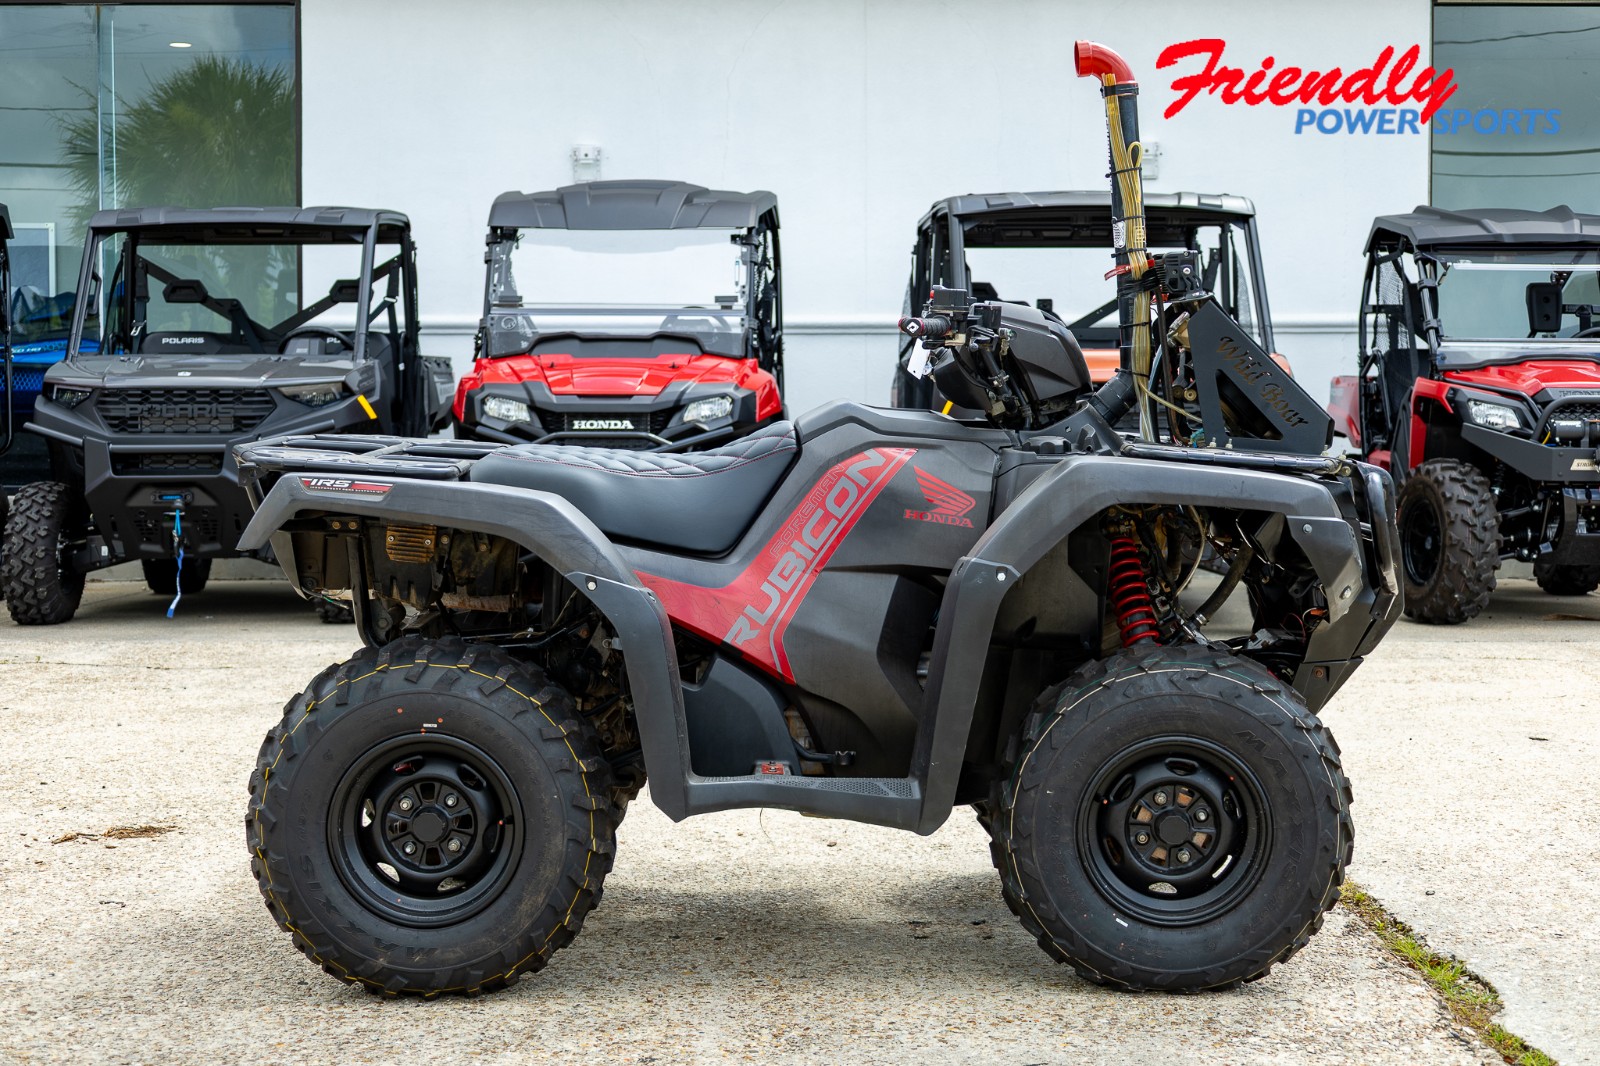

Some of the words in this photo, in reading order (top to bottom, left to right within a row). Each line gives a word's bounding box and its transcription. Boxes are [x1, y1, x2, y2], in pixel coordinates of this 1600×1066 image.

[162, 336, 205, 345] POLARIS
[125, 403, 235, 418] POLARIS
[1261, 383, 1309, 427] Boar
[572, 419, 635, 430] HONDA
[310, 478, 352, 488] IRS
[769, 463, 846, 559] FOREMAN
[903, 508, 975, 529] HONDA
[722, 449, 887, 646] RUBICON
